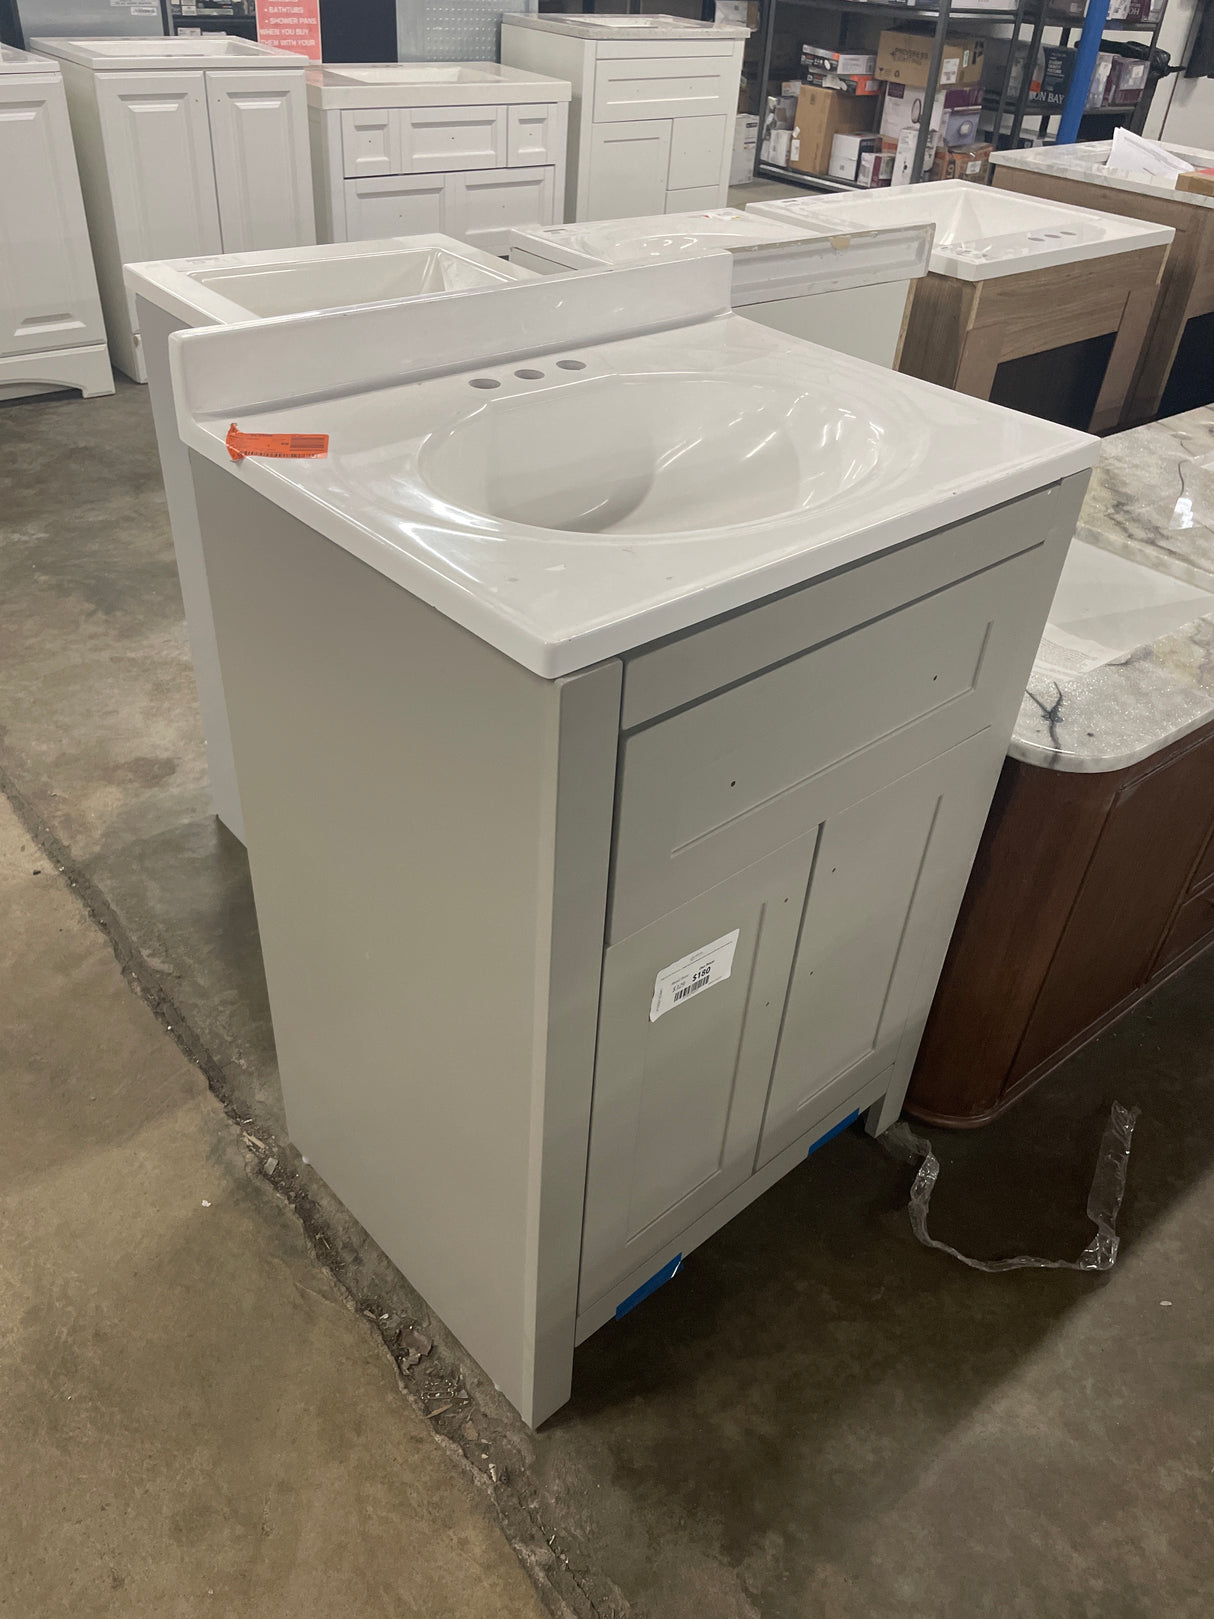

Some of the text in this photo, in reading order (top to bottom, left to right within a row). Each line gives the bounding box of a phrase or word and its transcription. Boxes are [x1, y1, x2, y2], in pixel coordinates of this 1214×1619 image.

[268, 6, 304, 14] BATHTUBS
[270, 17, 317, 25] SHOWER PANS
[1047, 92, 1065, 104] BAY
[692, 966, 711, 982] $180
